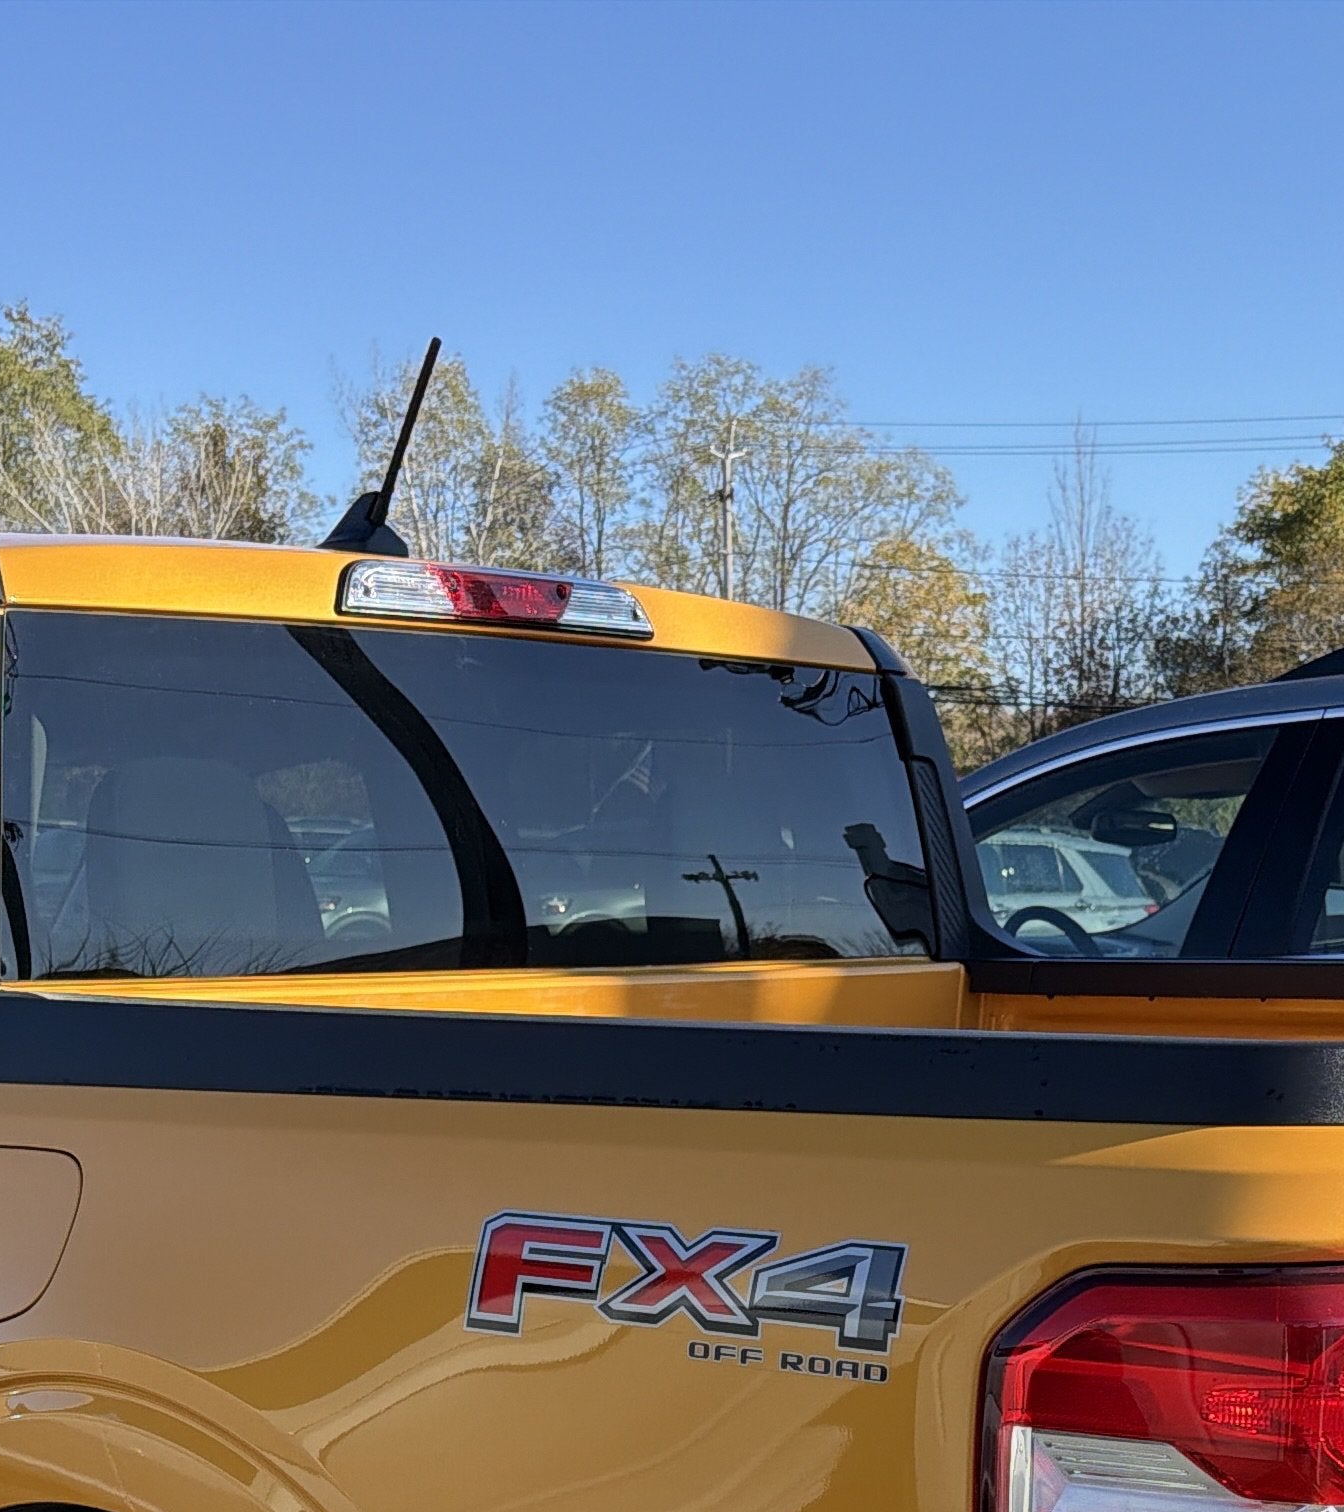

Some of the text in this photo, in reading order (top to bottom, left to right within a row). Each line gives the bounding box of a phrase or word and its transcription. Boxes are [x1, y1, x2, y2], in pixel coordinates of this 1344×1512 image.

[463, 1210, 909, 1355] FX4
[687, 1340, 890, 1383] OFF ROAD
